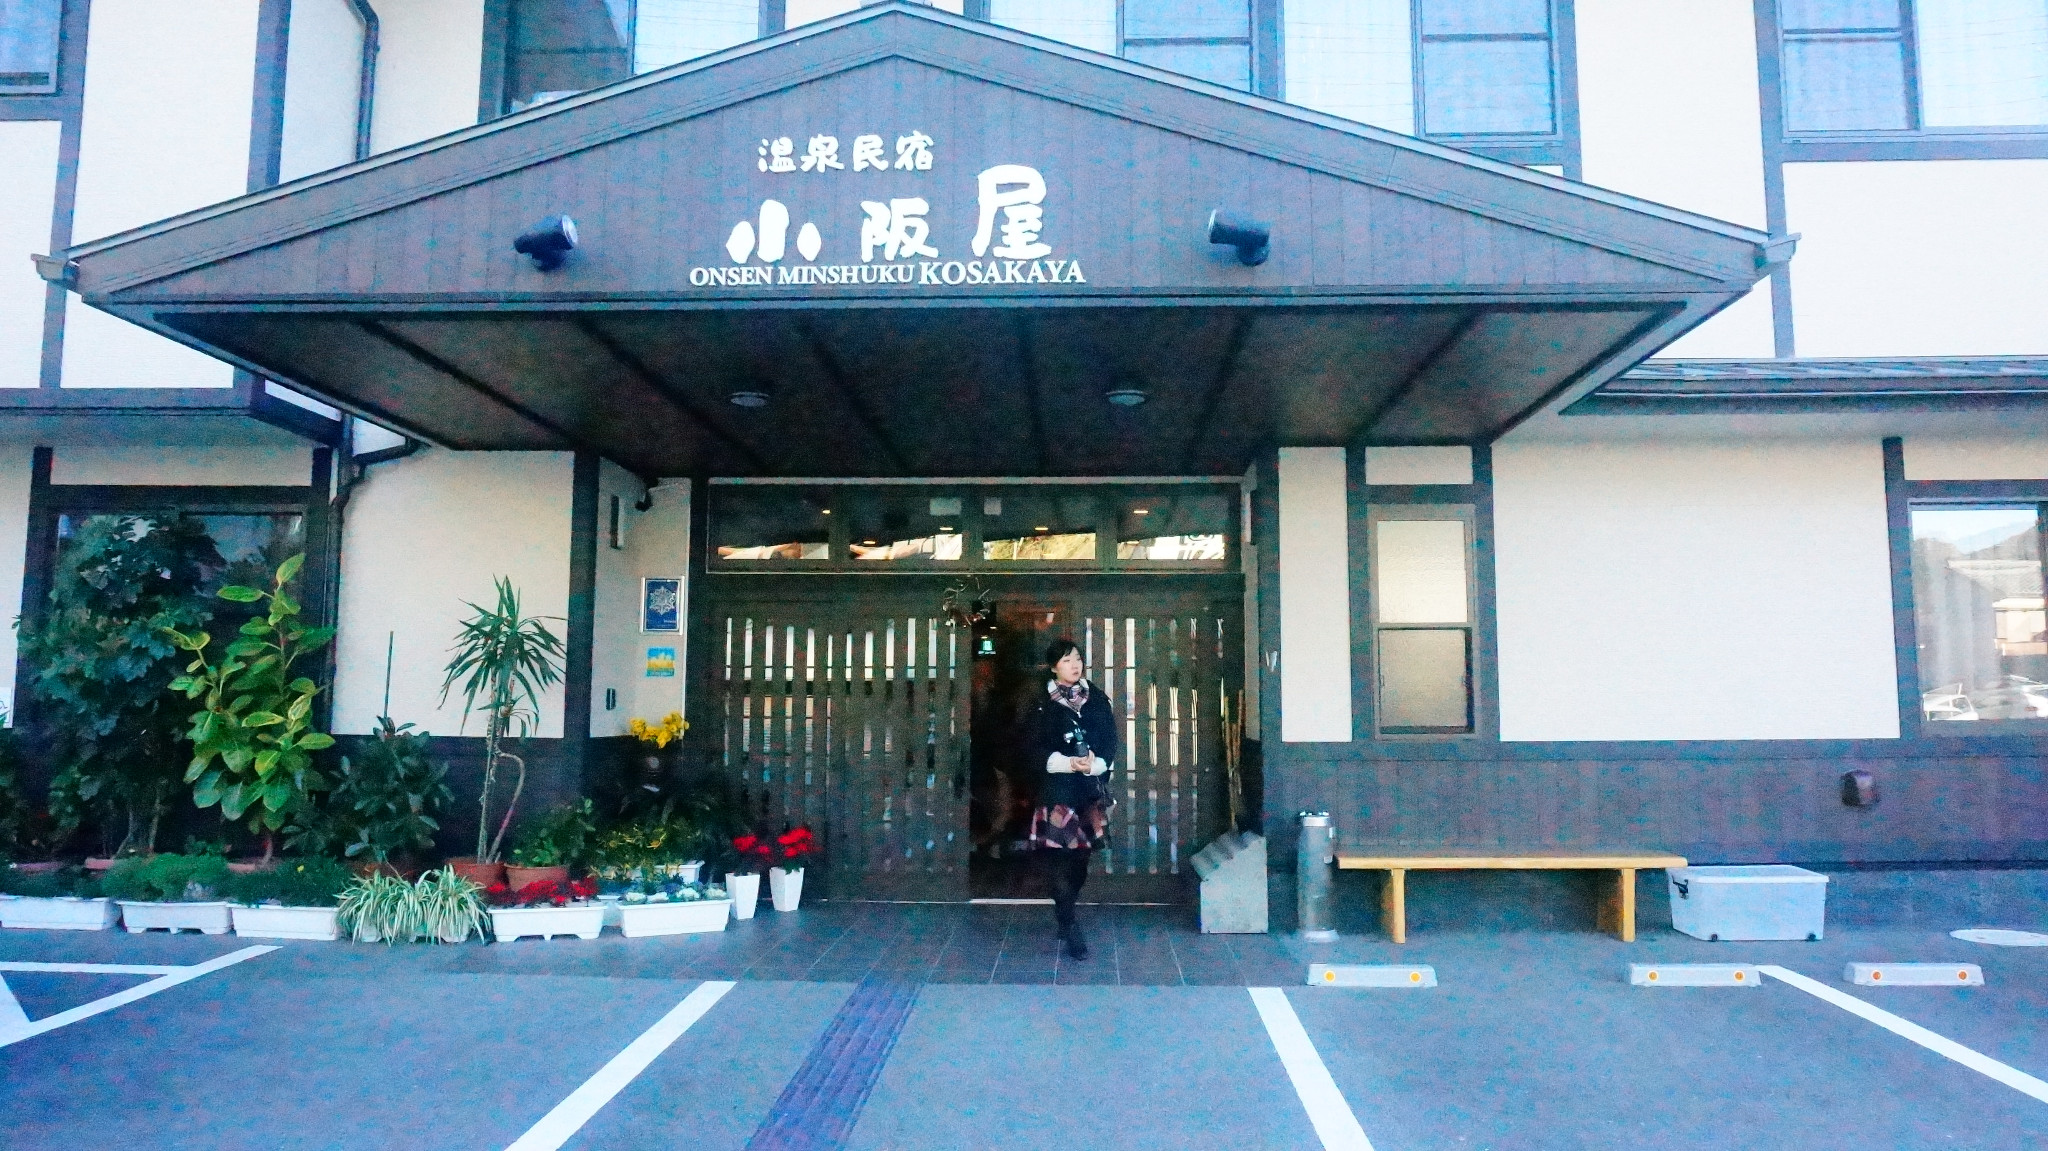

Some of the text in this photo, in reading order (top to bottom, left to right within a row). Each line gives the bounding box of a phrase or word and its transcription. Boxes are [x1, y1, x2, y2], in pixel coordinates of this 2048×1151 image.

[757, 130, 935, 173] 温泉民宿
[725, 164, 1052, 263] 小阪屋
[689, 260, 1087, 287] ONSEN MINSHUKU KOSAKAYA
